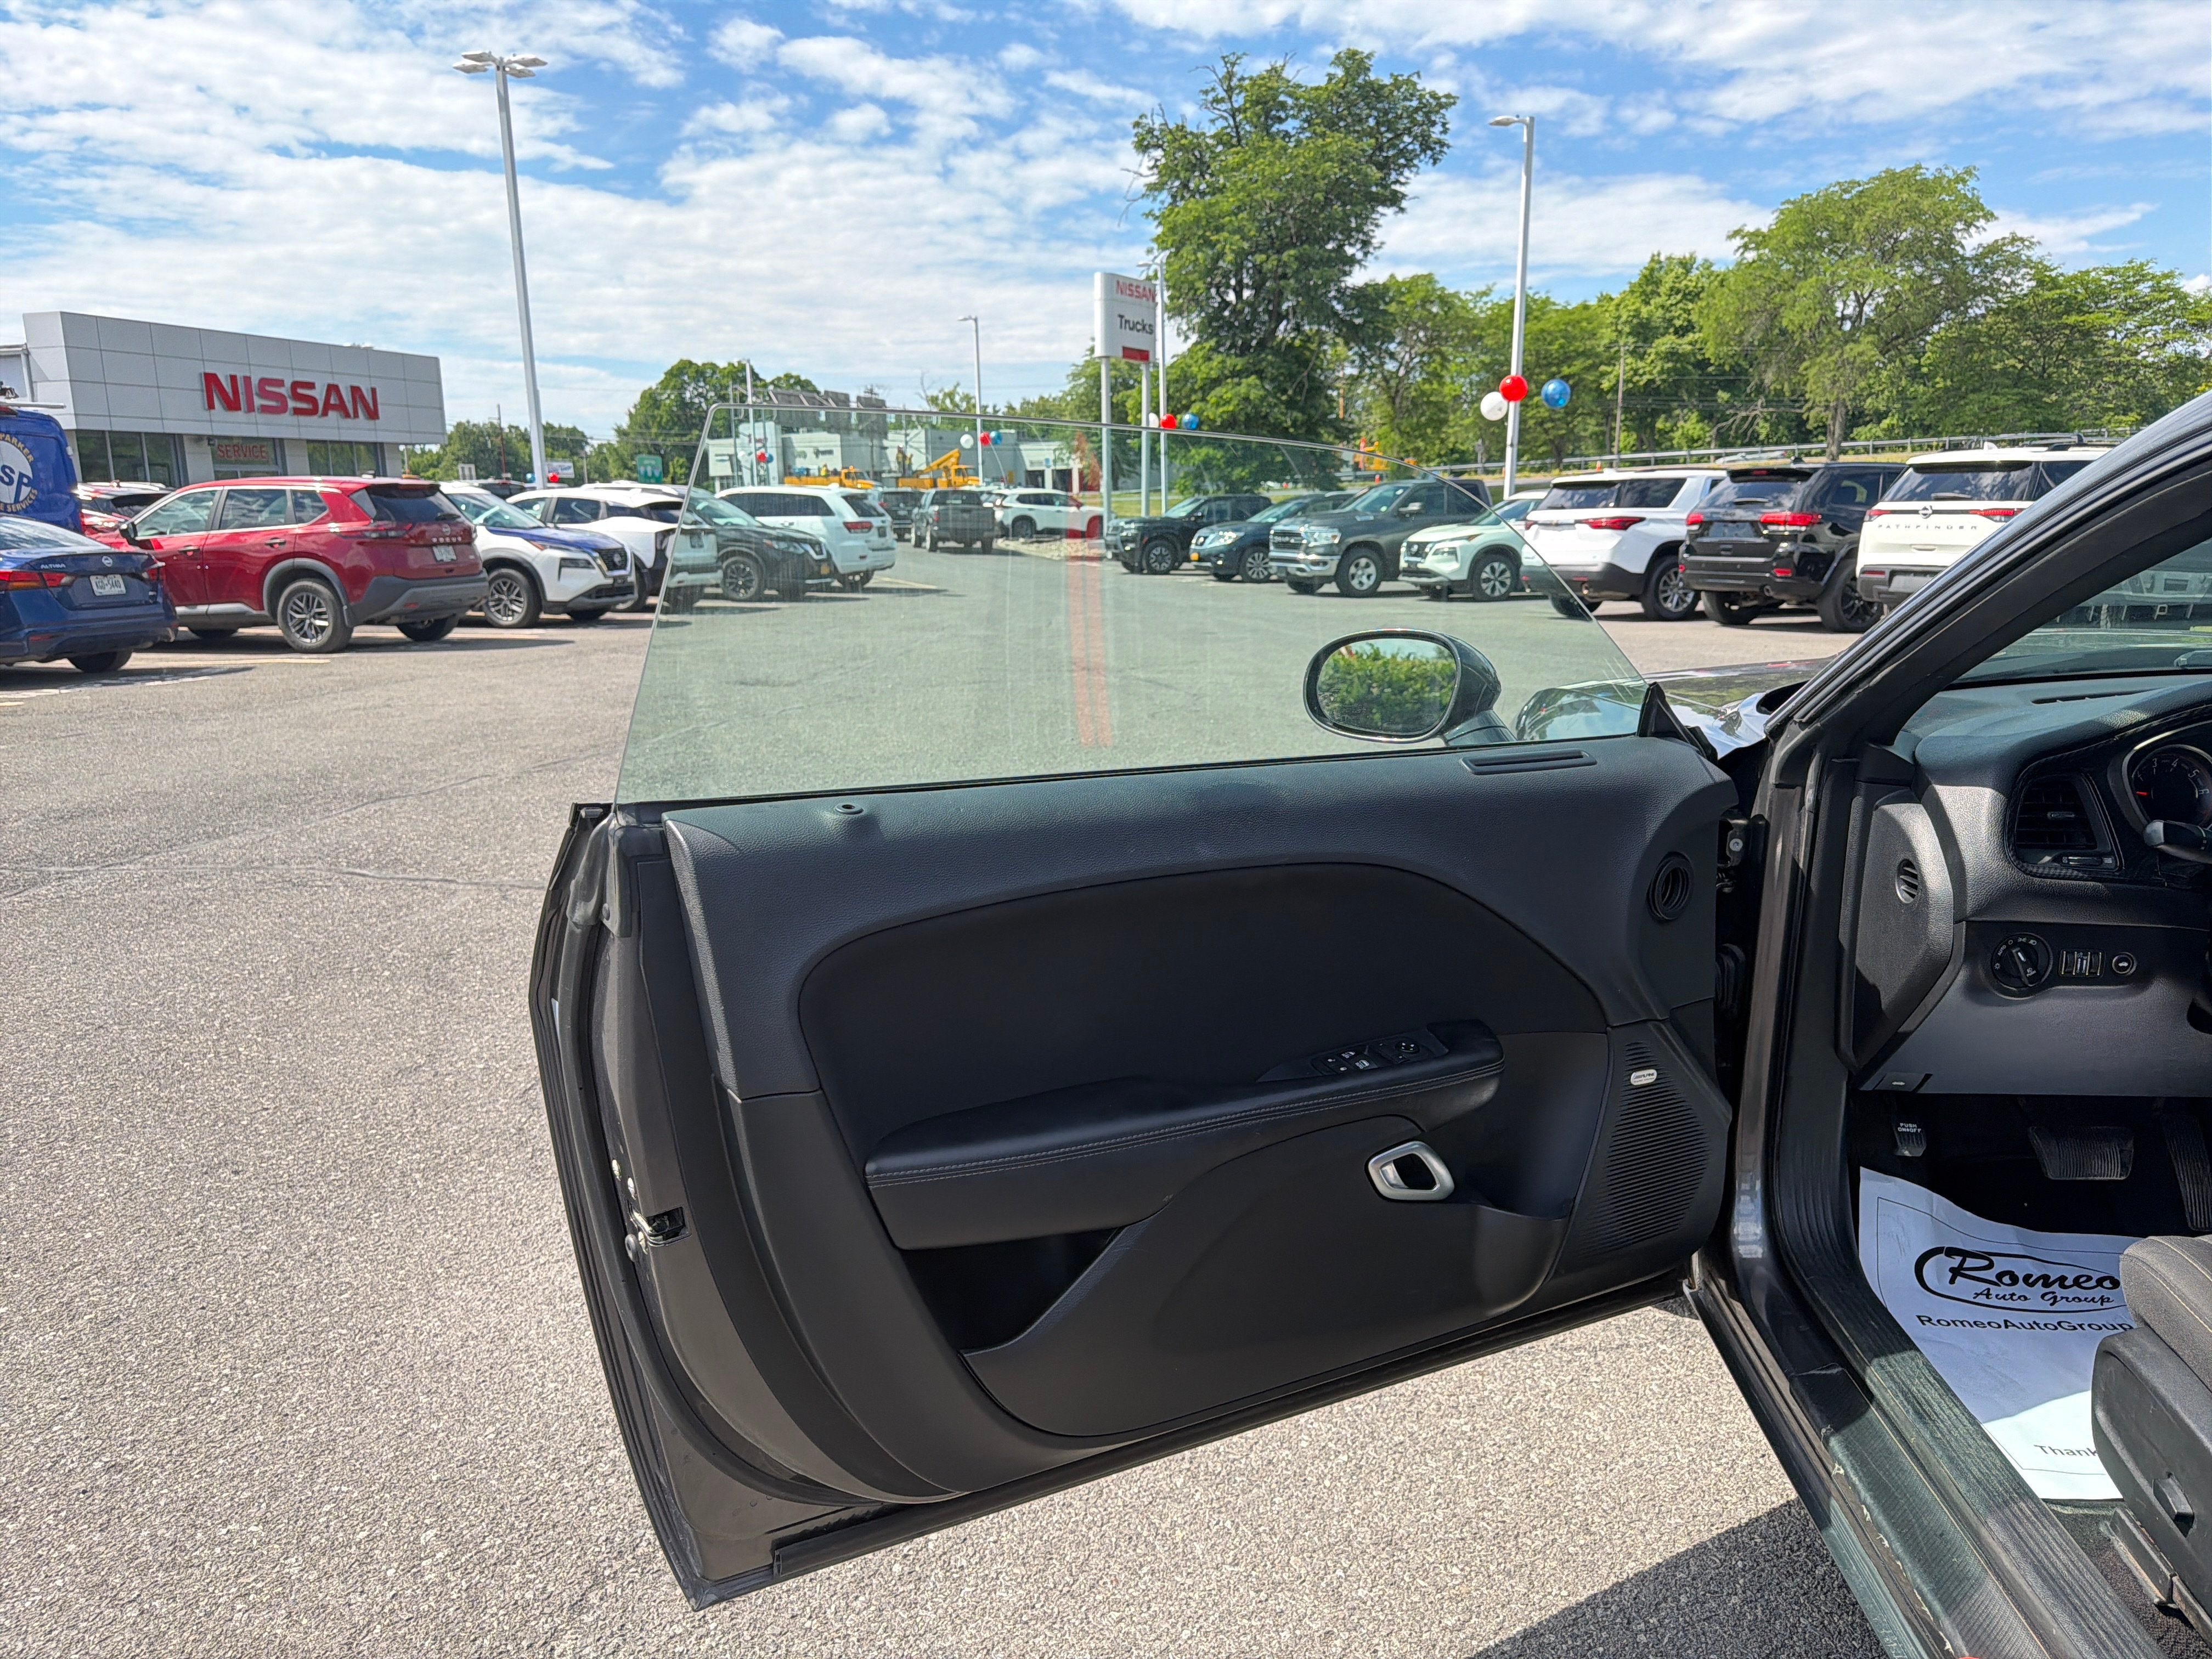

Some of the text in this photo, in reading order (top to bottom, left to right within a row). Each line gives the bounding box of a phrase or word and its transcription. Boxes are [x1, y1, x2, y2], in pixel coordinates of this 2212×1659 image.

[1116, 280, 1156, 302] NISSAN
[1118, 313, 1154, 335] Trucks
[203, 372, 380, 420] NISSAN
[217, 444, 267, 459] SERVICE
[7, 488, 38, 512] SERVICES
[2152, 758, 2157, 768] 3
[2171, 758, 2179, 768] 4
[2187, 769, 2200, 777] 5
[1997, 945, 2007, 956] AUTO
[1944, 1246, 2120, 1290] Romeo
[1973, 1288, 2114, 1306] Auto Group
[1916, 1314, 2134, 1331] RomeoAutoGroup
[2033, 1444, 2097, 1457] Thank
